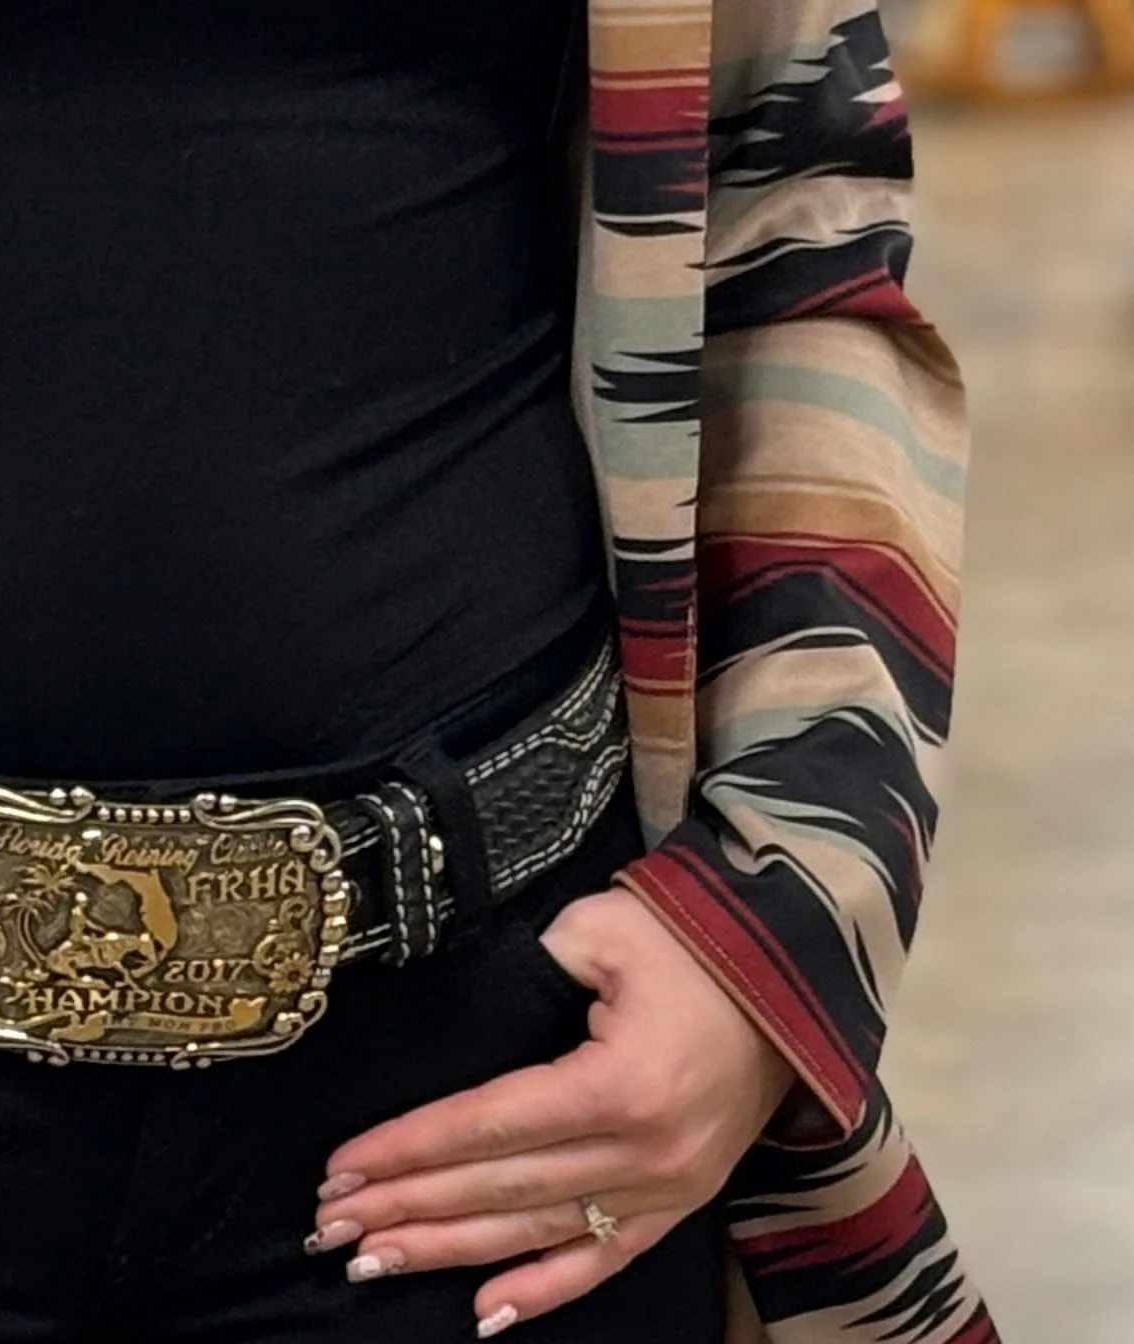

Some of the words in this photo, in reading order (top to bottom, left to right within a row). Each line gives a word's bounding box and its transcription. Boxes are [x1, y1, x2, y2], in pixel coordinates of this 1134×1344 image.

[95, 833, 199, 876] Reining
[187, 858, 306, 904] FRHA
[164, 959, 249, 983] 2017
